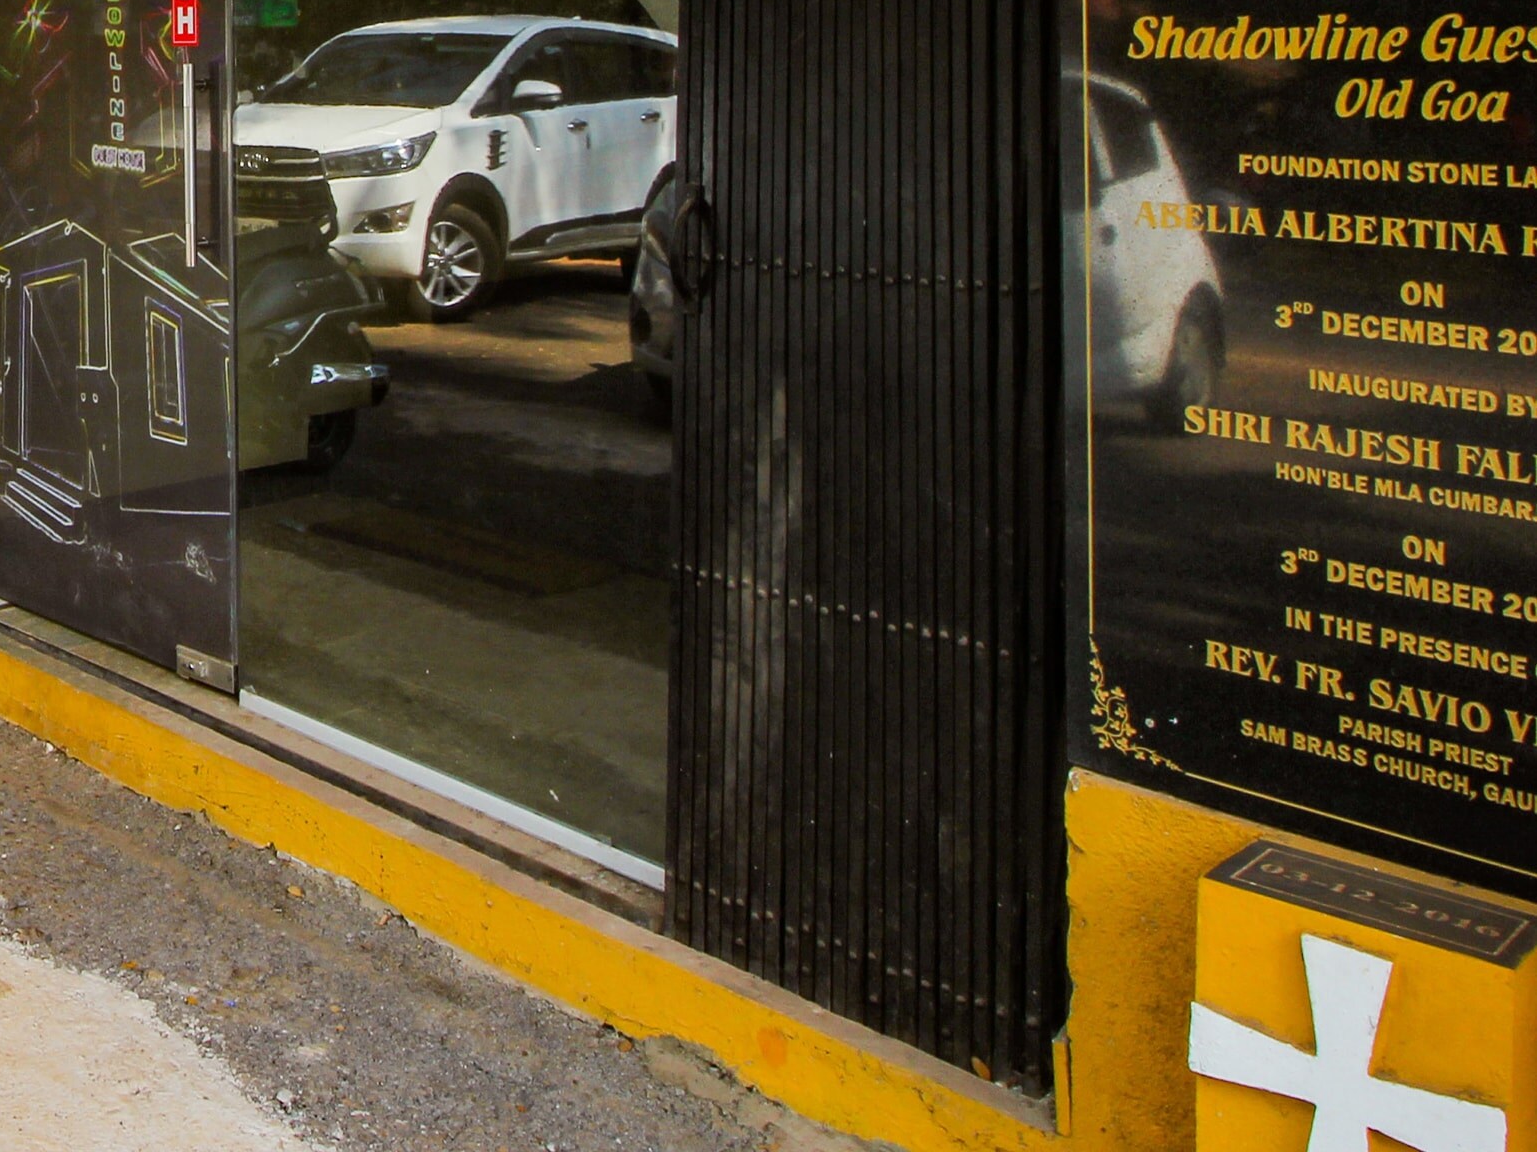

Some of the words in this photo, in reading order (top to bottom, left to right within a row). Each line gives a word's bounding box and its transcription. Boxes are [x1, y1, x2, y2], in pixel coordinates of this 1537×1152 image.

[1128, 13, 1409, 62] Shadowline
[1335, 78, 1413, 119] Old
[1421, 80, 1510, 122] Goa
[1238, 154, 1400, 181] FOUNDATION
[1407, 162, 1498, 187] STONE
[1507, 167, 1537, 188] LA
[1134, 201, 1266, 236] ABELIA
[1276, 210, 1508, 256] ALBERTINA
[1400, 281, 1445, 308] ON
[1322, 310, 1489, 351] DECEMBER
[1309, 369, 1497, 413] INAUGURATED
[1184, 405, 1271, 443] SHRI
[1286, 419, 1440, 470] RAJESH
[1457, 444, 1537, 485] FAL
[1276, 463, 1368, 493] HON'BLE
[1375, 479, 1423, 503] MLA
[1429, 487, 1537, 522] CUMBAR
[1402, 536, 1445, 566] ON
[1327, 558, 1493, 614] DECEMBER
[1286, 606, 1311, 632] IN
[1320, 614, 1373, 645] THE
[1381, 628, 1526, 678] PRESENCE
[1205, 639, 1281, 683] REV.
[1295, 661, 1355, 701] FR.
[1369, 678, 1491, 732] SAVIO
[1240, 719, 1286, 746] SAM
[1292, 732, 1367, 767] BRASS
[1374, 753, 1477, 800] CHURCH,
[1483, 783, 1537, 819] GAU
[1339, 716, 1422, 753] PARISH
[1429, 738, 1513, 775] PRIEST
